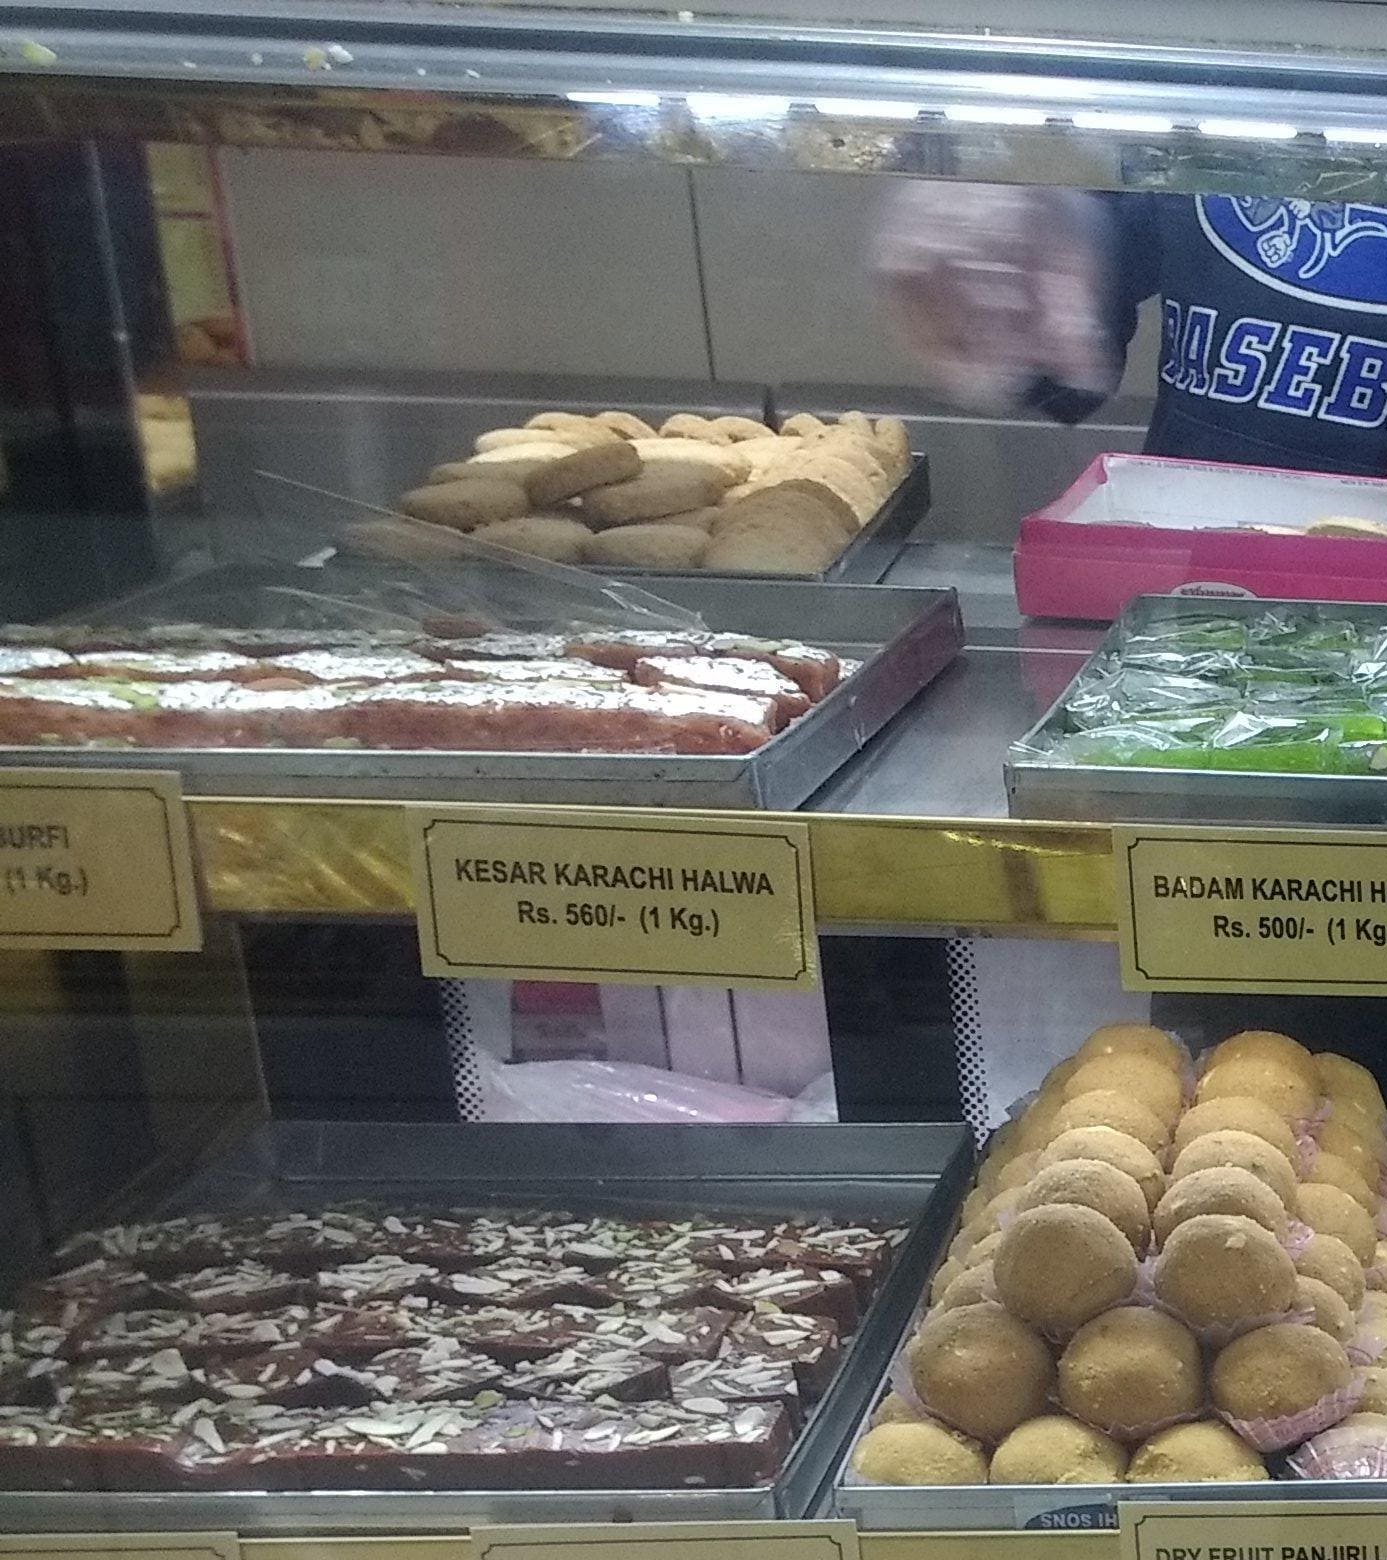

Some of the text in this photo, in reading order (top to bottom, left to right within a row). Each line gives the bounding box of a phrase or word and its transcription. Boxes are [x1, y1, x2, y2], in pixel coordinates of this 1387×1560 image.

[455, 858, 775, 895] KESAR KARACHI HALWA
[1153, 875, 1244, 900] BADAM
[1253, 878, 1361, 902] KARACHI
[518, 901, 719, 937] Rs. 560/- (1 Kg.)
[1214, 916, 1250, 938] Rs.
[1259, 917, 1314, 940] 500/-
[1328, 918, 1345, 945] (1
